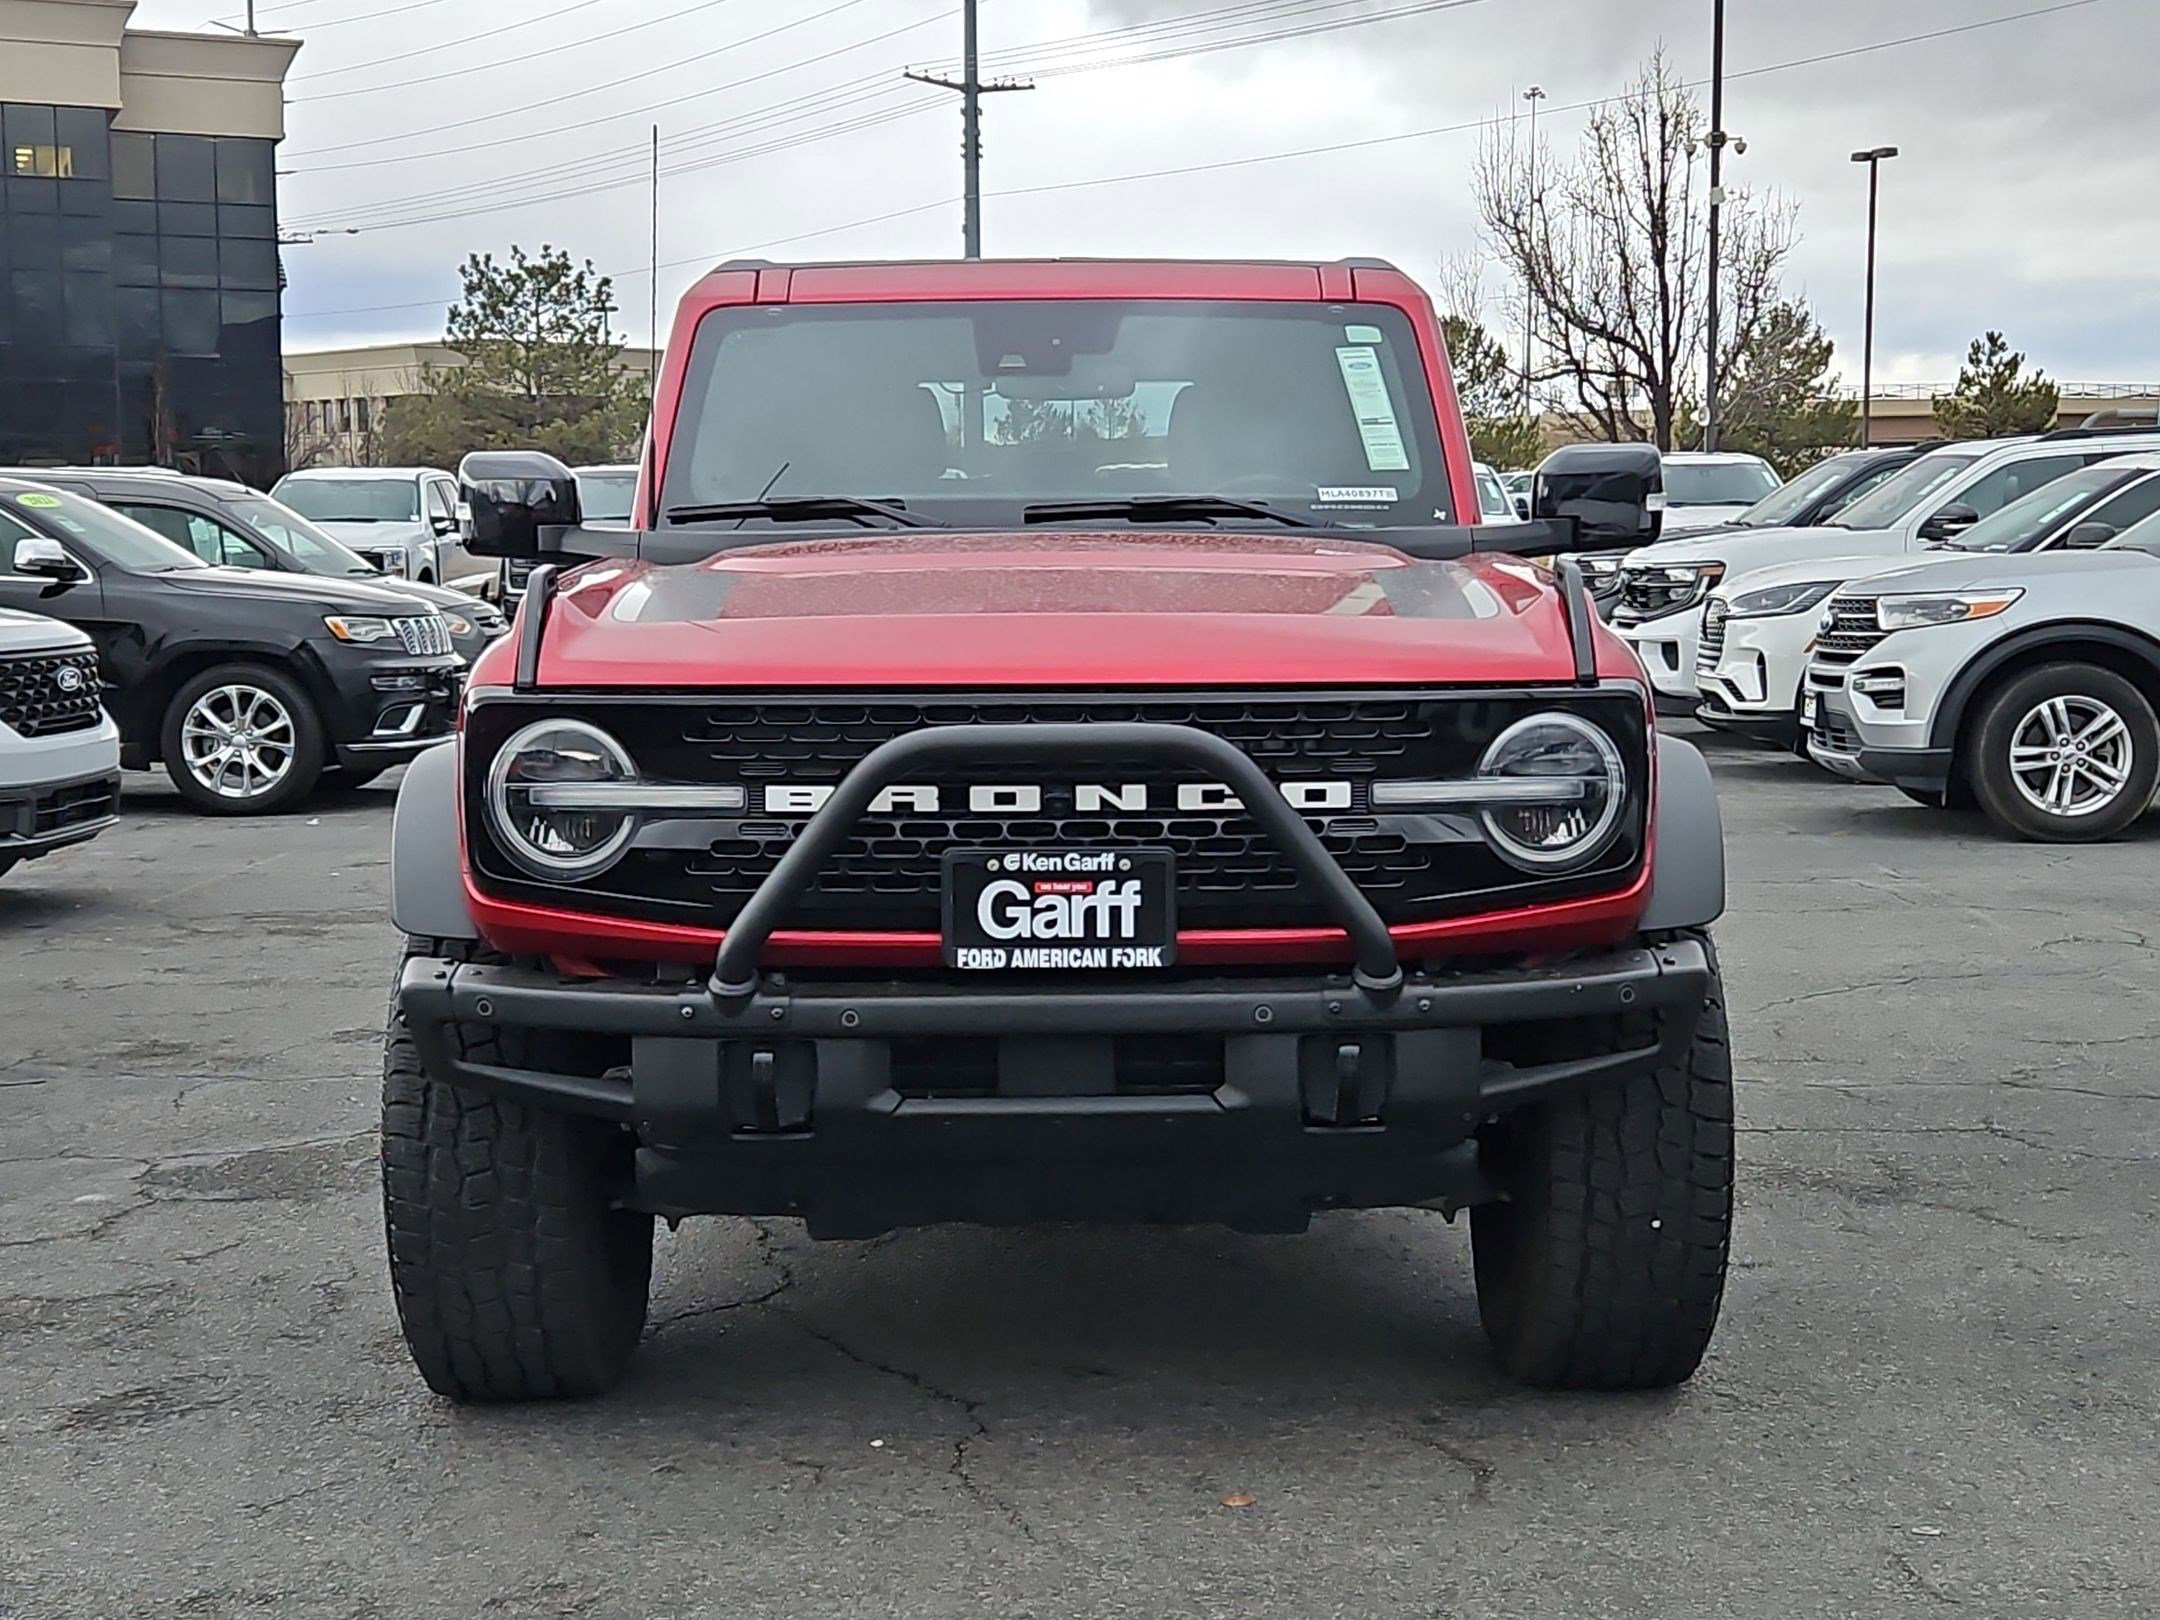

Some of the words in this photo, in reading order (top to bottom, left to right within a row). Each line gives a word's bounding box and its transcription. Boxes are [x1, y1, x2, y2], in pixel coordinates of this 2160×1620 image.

[765, 781, 1351, 812] BRONCO
[1022, 853, 1062, 871] Ken
[1063, 852, 1116, 871] Garff
[977, 879, 1142, 940] Garff
[957, 948, 1007, 968] FORD
[1010, 948, 1107, 968] AMERICAN
[1112, 947, 1163, 967] FORK
